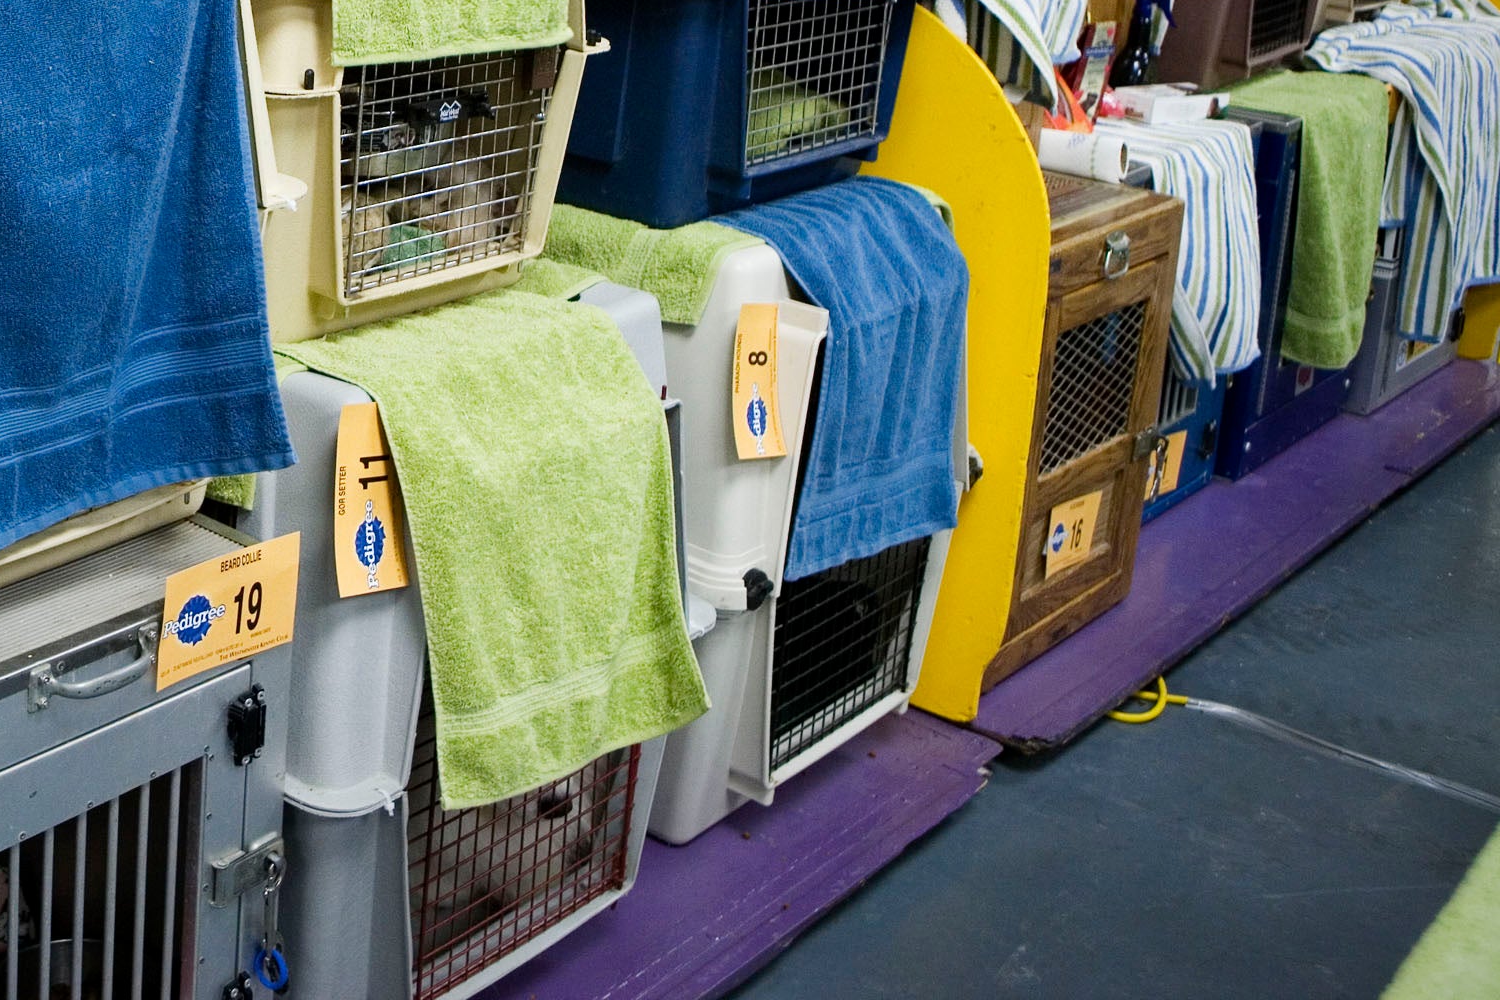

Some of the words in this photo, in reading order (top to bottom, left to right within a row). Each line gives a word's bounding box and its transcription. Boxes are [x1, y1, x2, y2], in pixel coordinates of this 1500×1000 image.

[748, 350, 768, 366] 8
[339, 465, 347, 496] SETTER
[358, 455, 390, 490] 11
[338, 498, 346, 516] GOR
[364, 499, 379, 589] Pedigree
[1070, 518, 1083, 551] 16
[220, 556, 241, 573] BEARD
[241, 550, 262, 566] COLLIE
[162, 604, 226, 640] Pedigree
[234, 581, 263, 635] 19
